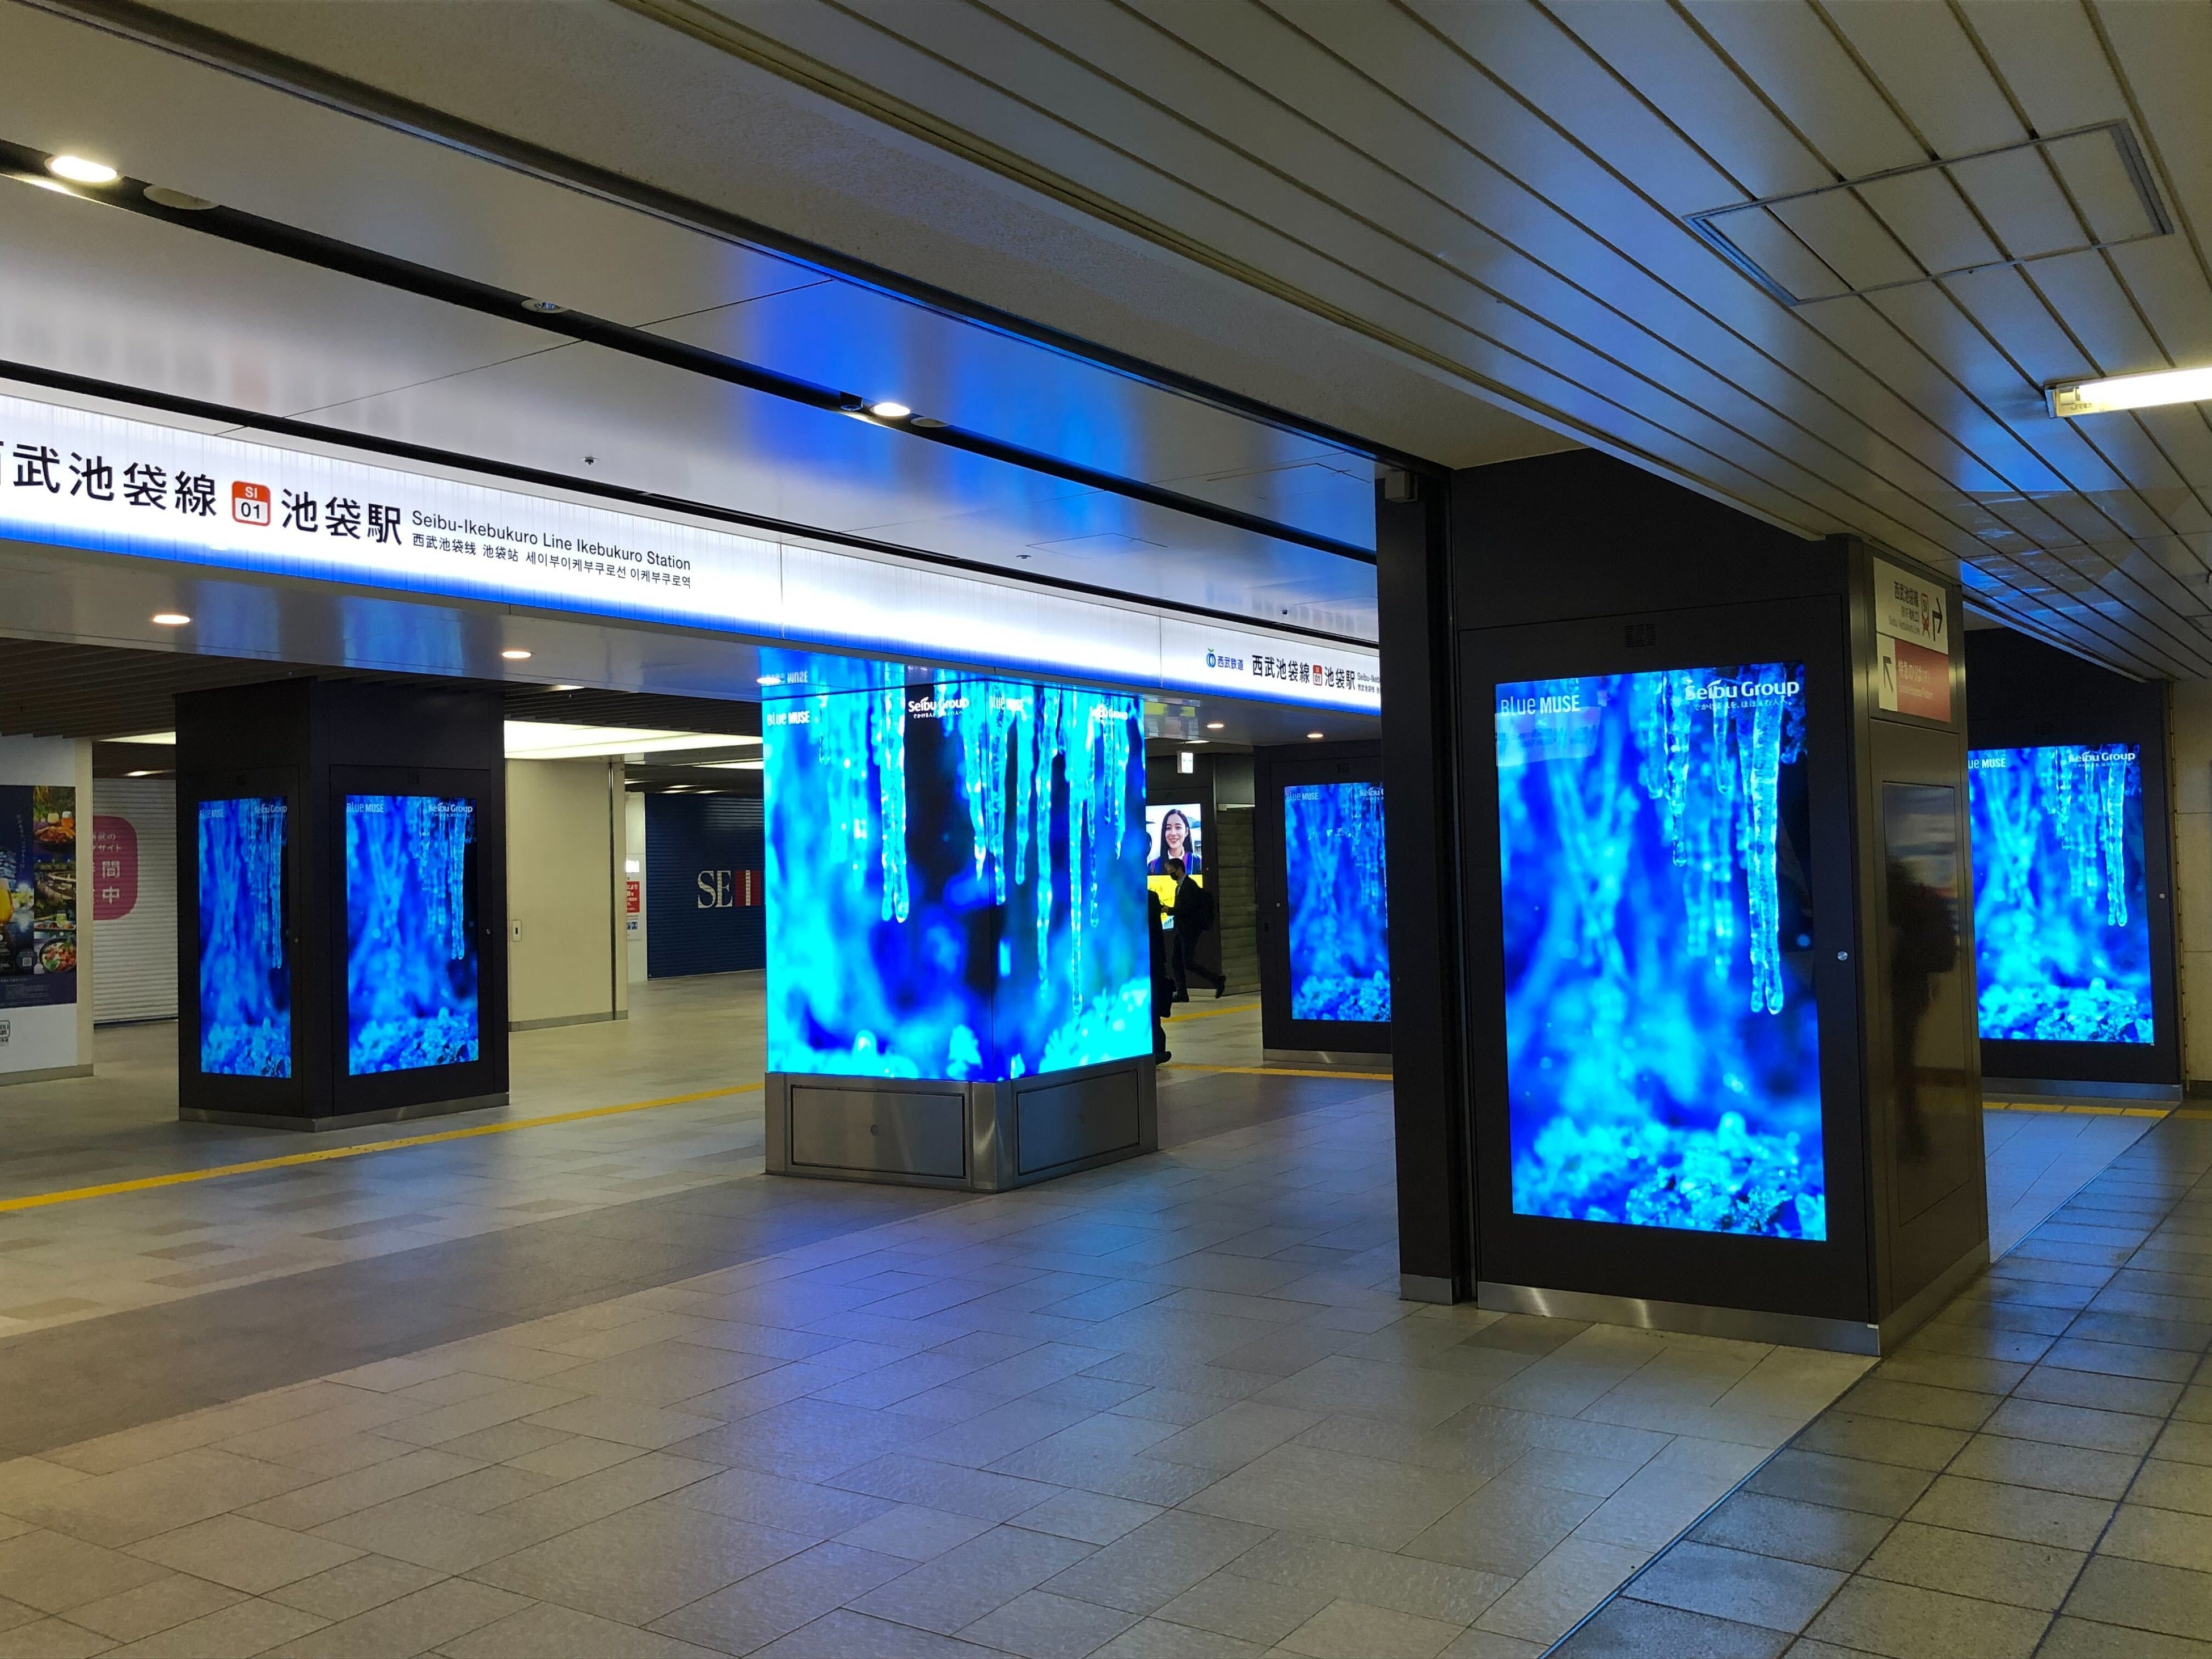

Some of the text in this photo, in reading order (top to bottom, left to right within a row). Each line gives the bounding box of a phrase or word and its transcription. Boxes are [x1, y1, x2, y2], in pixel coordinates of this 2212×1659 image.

[0, 441, 402, 546] 武池袋線 池袋駅
[245, 486, 258, 499] SI
[240, 504, 261, 520] 01
[412, 510, 691, 571] Seibu-Ikebukuro Line Ikebukuro Station
[412, 533, 518, 562] 西武池袋线 池袋站
[525, 551, 691, 589] 세이부이케부쿠로선 이케부쿠로역
[1217, 655, 1244, 671] 西武鉄道
[1251, 654, 1356, 690] 西武池袋線 池袋駅
[1314, 674, 1320, 683] 01
[1685, 679, 1800, 701] Seibu Group
[908, 696, 937, 712] Seibu
[1501, 694, 1580, 717] Blue MUSE
[788, 710, 810, 725] MUSE
[1981, 758, 2006, 769] MUSE
[2101, 752, 2136, 762] Group
[1302, 792, 1319, 800] MUSE
[270, 804, 288, 814] Group
[365, 803, 385, 813] MUSE
[450, 804, 473, 813] Group
[697, 869, 751, 909] SEI
